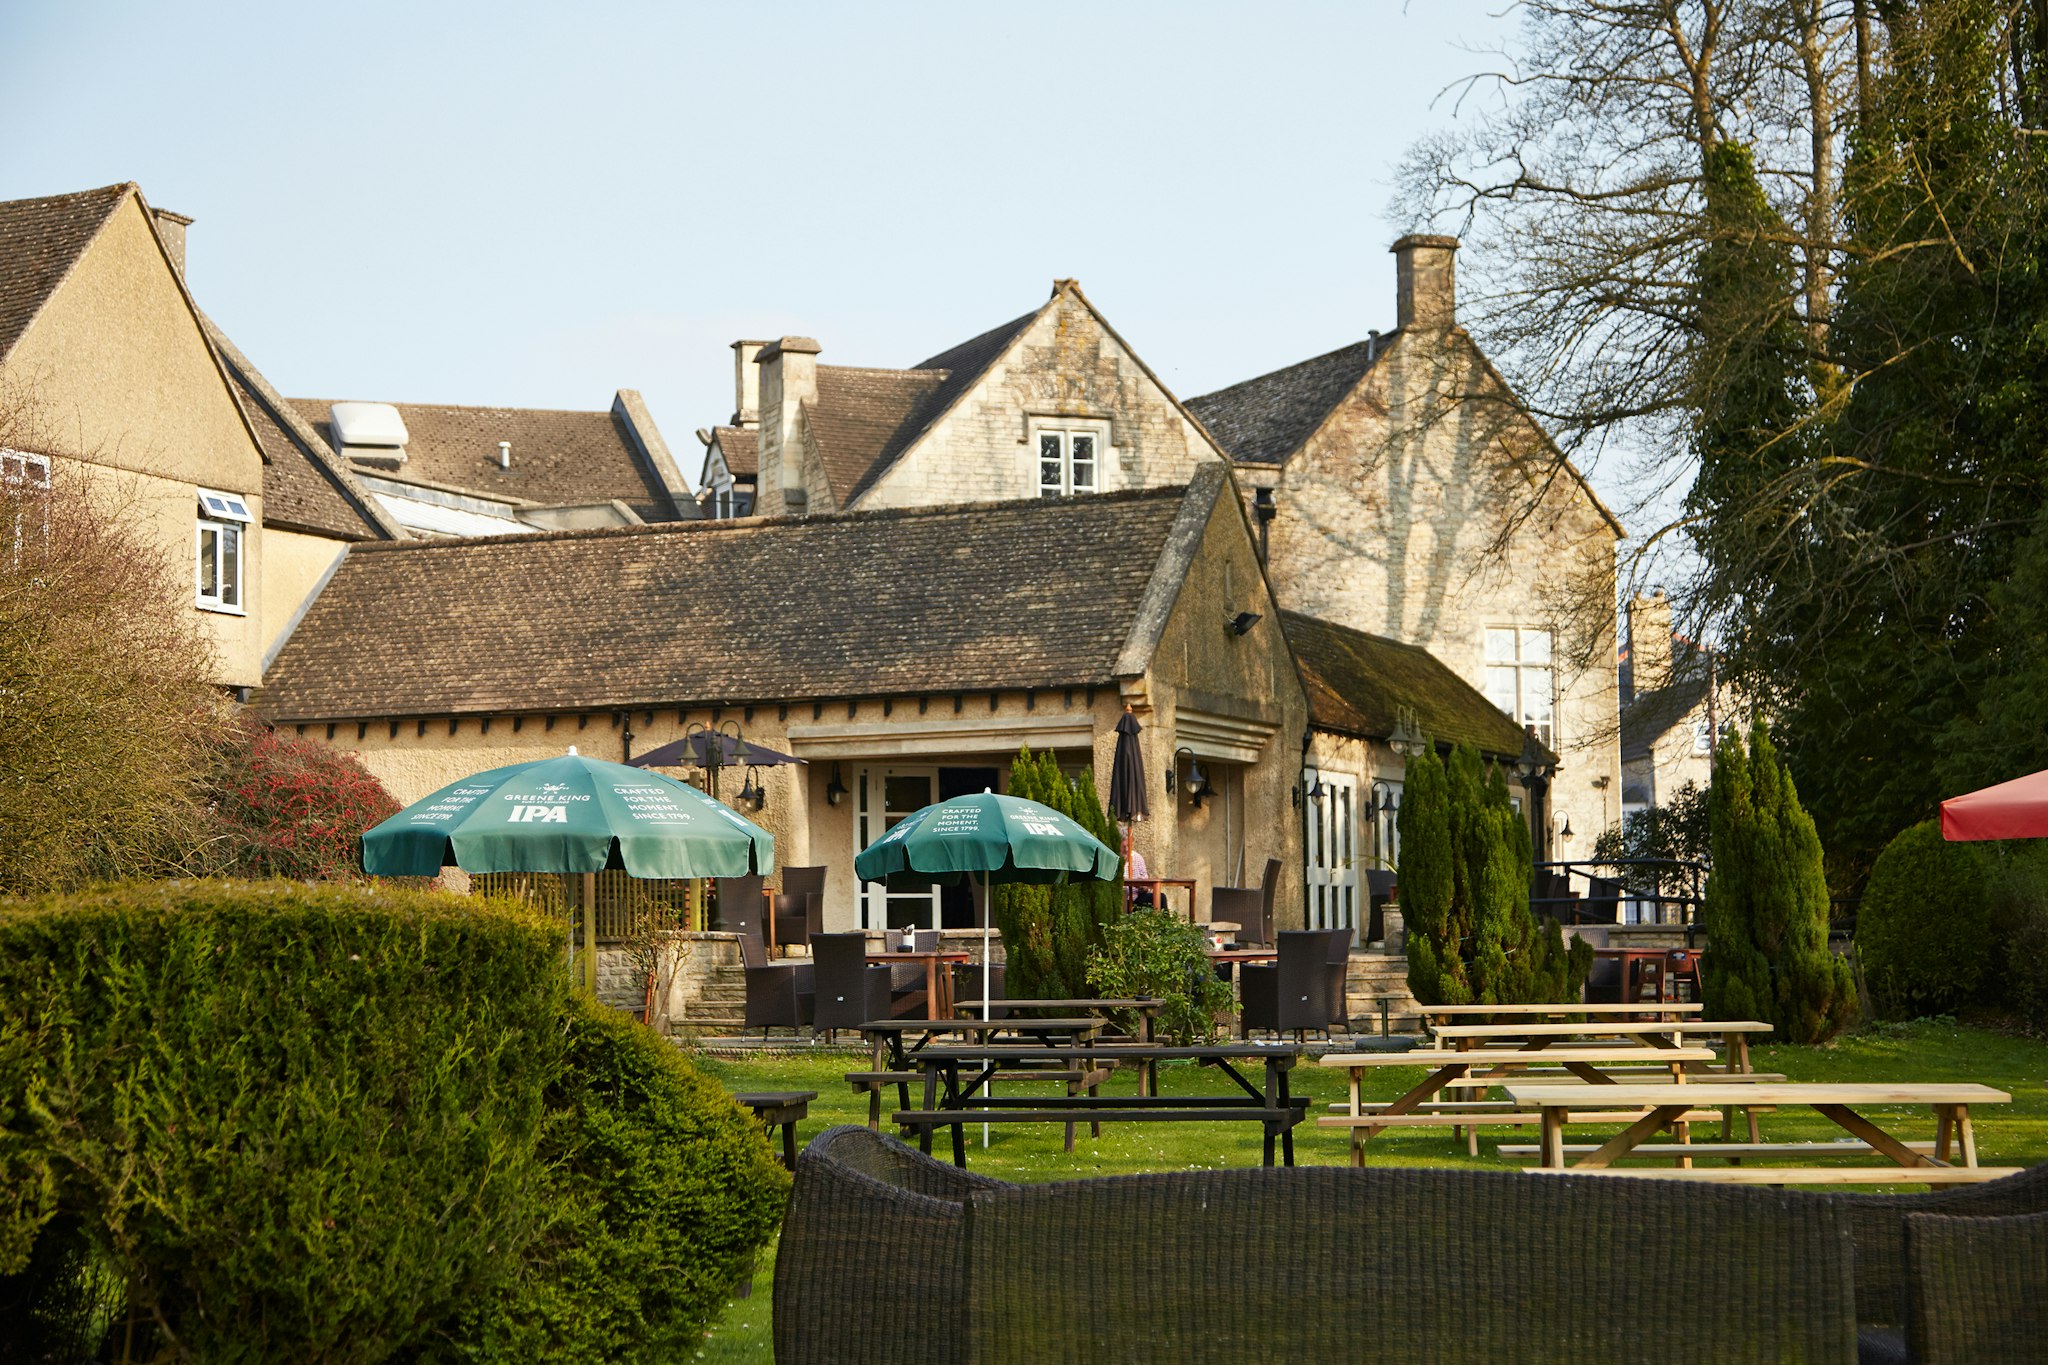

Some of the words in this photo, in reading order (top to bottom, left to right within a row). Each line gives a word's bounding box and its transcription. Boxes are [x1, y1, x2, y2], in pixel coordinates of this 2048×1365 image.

[613, 787, 665, 795] CRAFTED
[507, 805, 568, 823] IPA
[632, 812, 667, 820] SINCE
[1022, 822, 1065, 836] IPA
